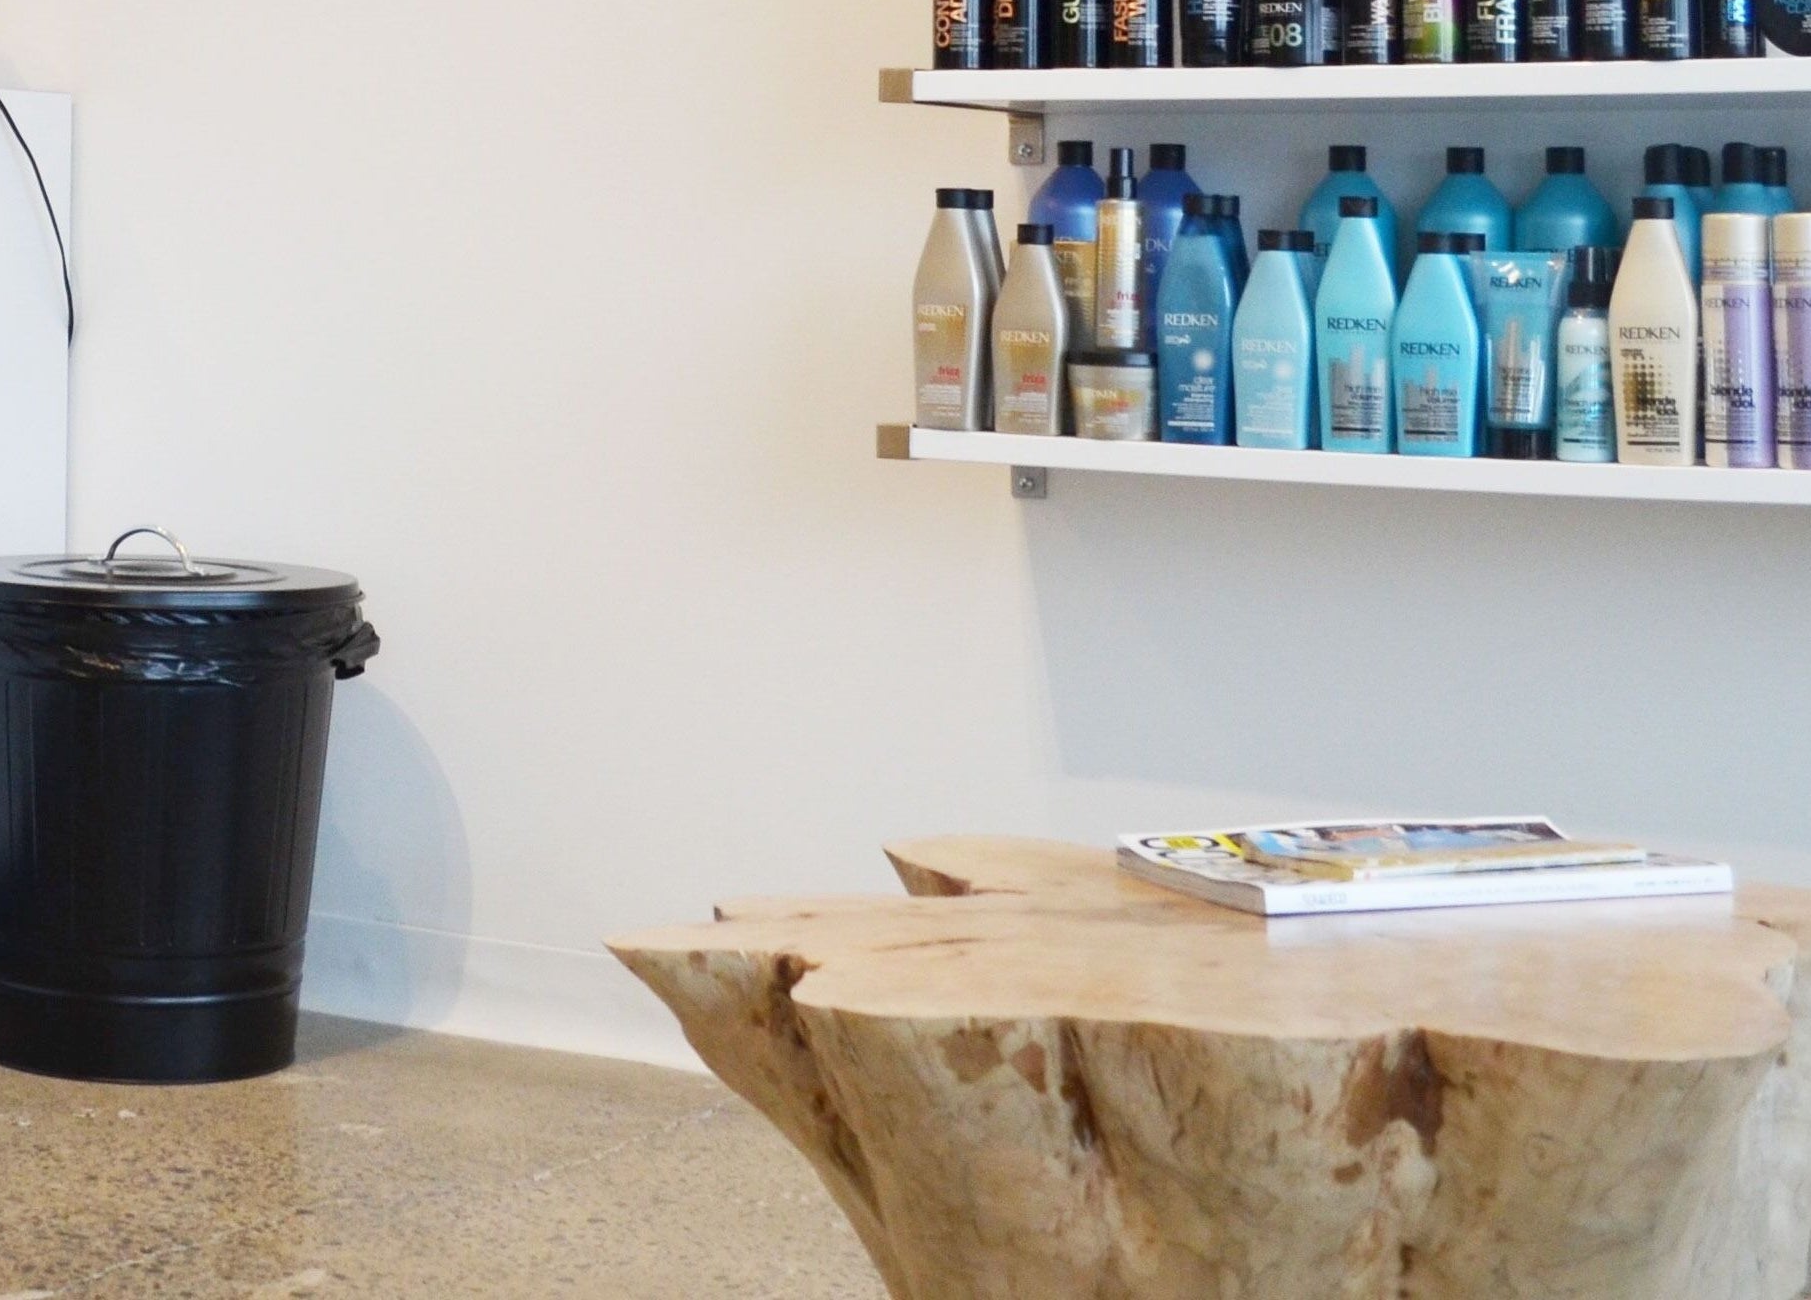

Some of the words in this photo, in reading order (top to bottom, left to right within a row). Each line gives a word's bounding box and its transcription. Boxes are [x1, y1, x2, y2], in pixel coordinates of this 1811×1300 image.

[1258, 2, 1303, 14] REDKEN
[1269, 23, 1304, 48] 08
[917, 304, 965, 317] REDKEN
[1164, 312, 1219, 327] REDKEN
[1327, 317, 1387, 331] REDKEN
[1000, 329, 1049, 343] REDKEN
[1619, 326, 1681, 340] REDKEN
[1241, 339, 1298, 353] REDKEN
[1401, 341, 1461, 356] REDKEN
[1711, 384, 1754, 396] blonde
